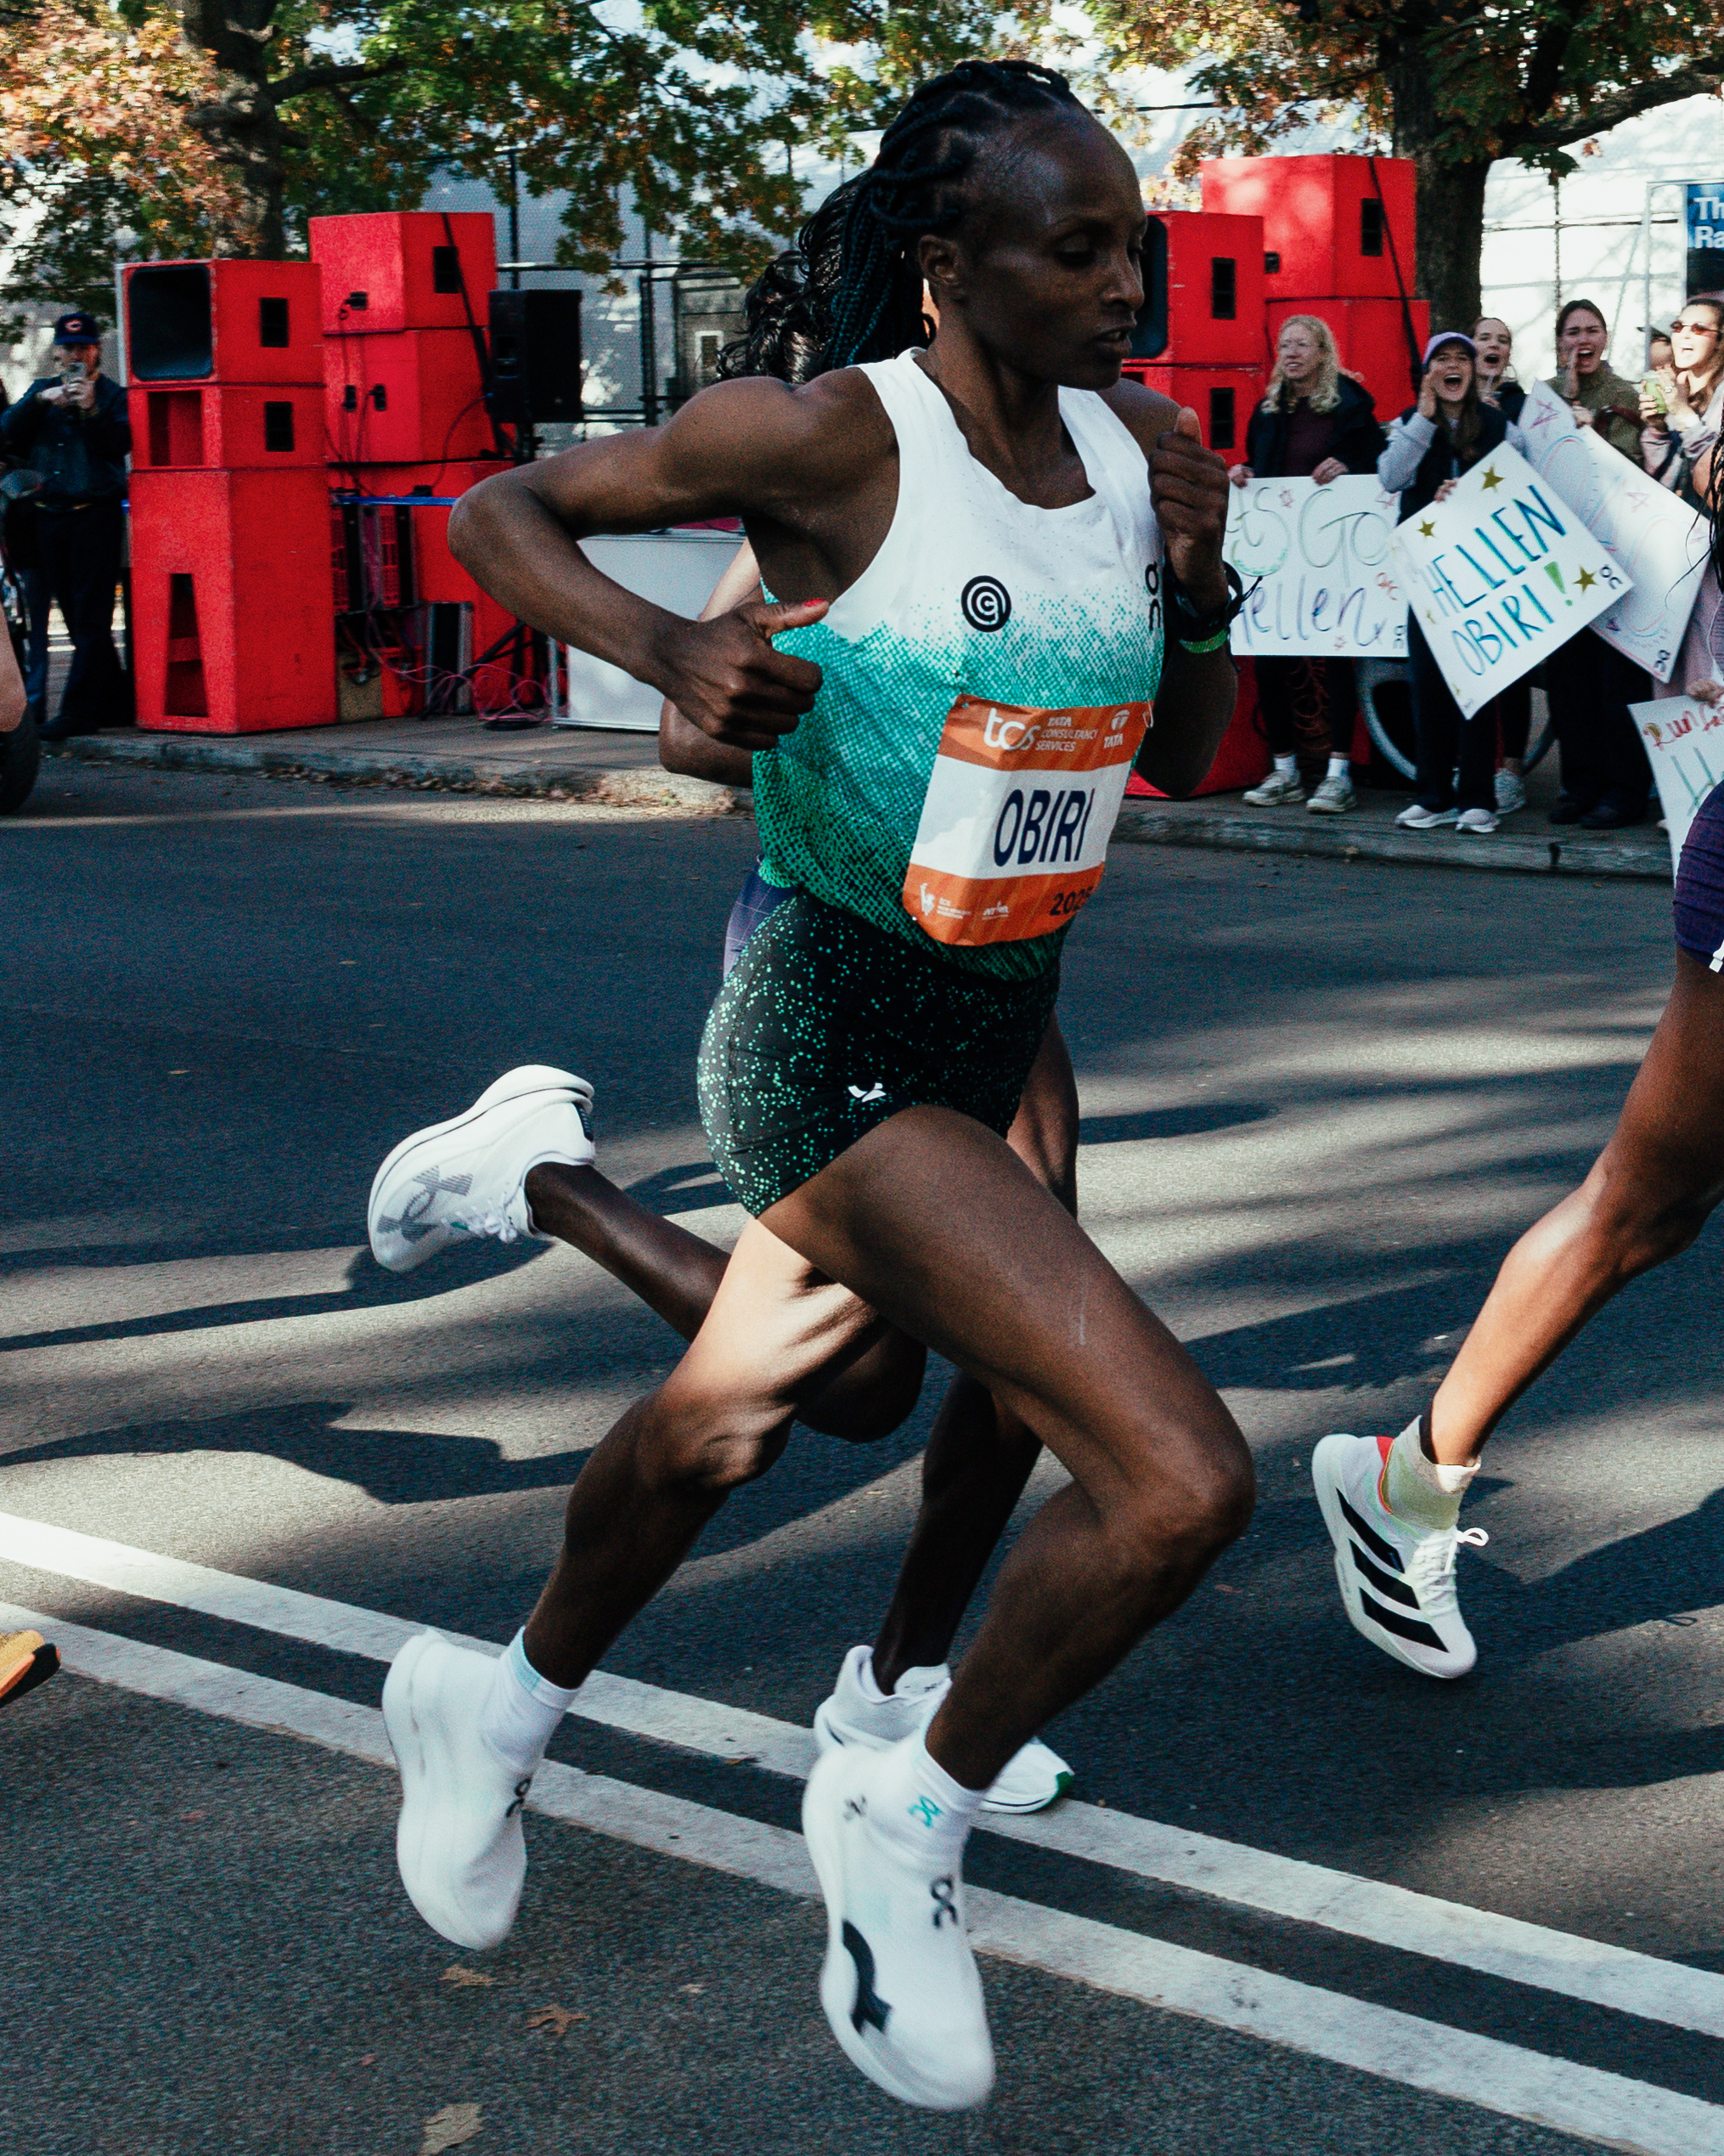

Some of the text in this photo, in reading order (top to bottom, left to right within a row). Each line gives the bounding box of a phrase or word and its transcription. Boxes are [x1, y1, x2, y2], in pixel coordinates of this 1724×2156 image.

[1422, 484, 1567, 617] HELLEN
[1048, 716, 1073, 728] TATA
[1035, 741, 1077, 752] SERVICES
[1103, 733, 1124, 748] TATA
[993, 787, 1096, 867] OBIRI
